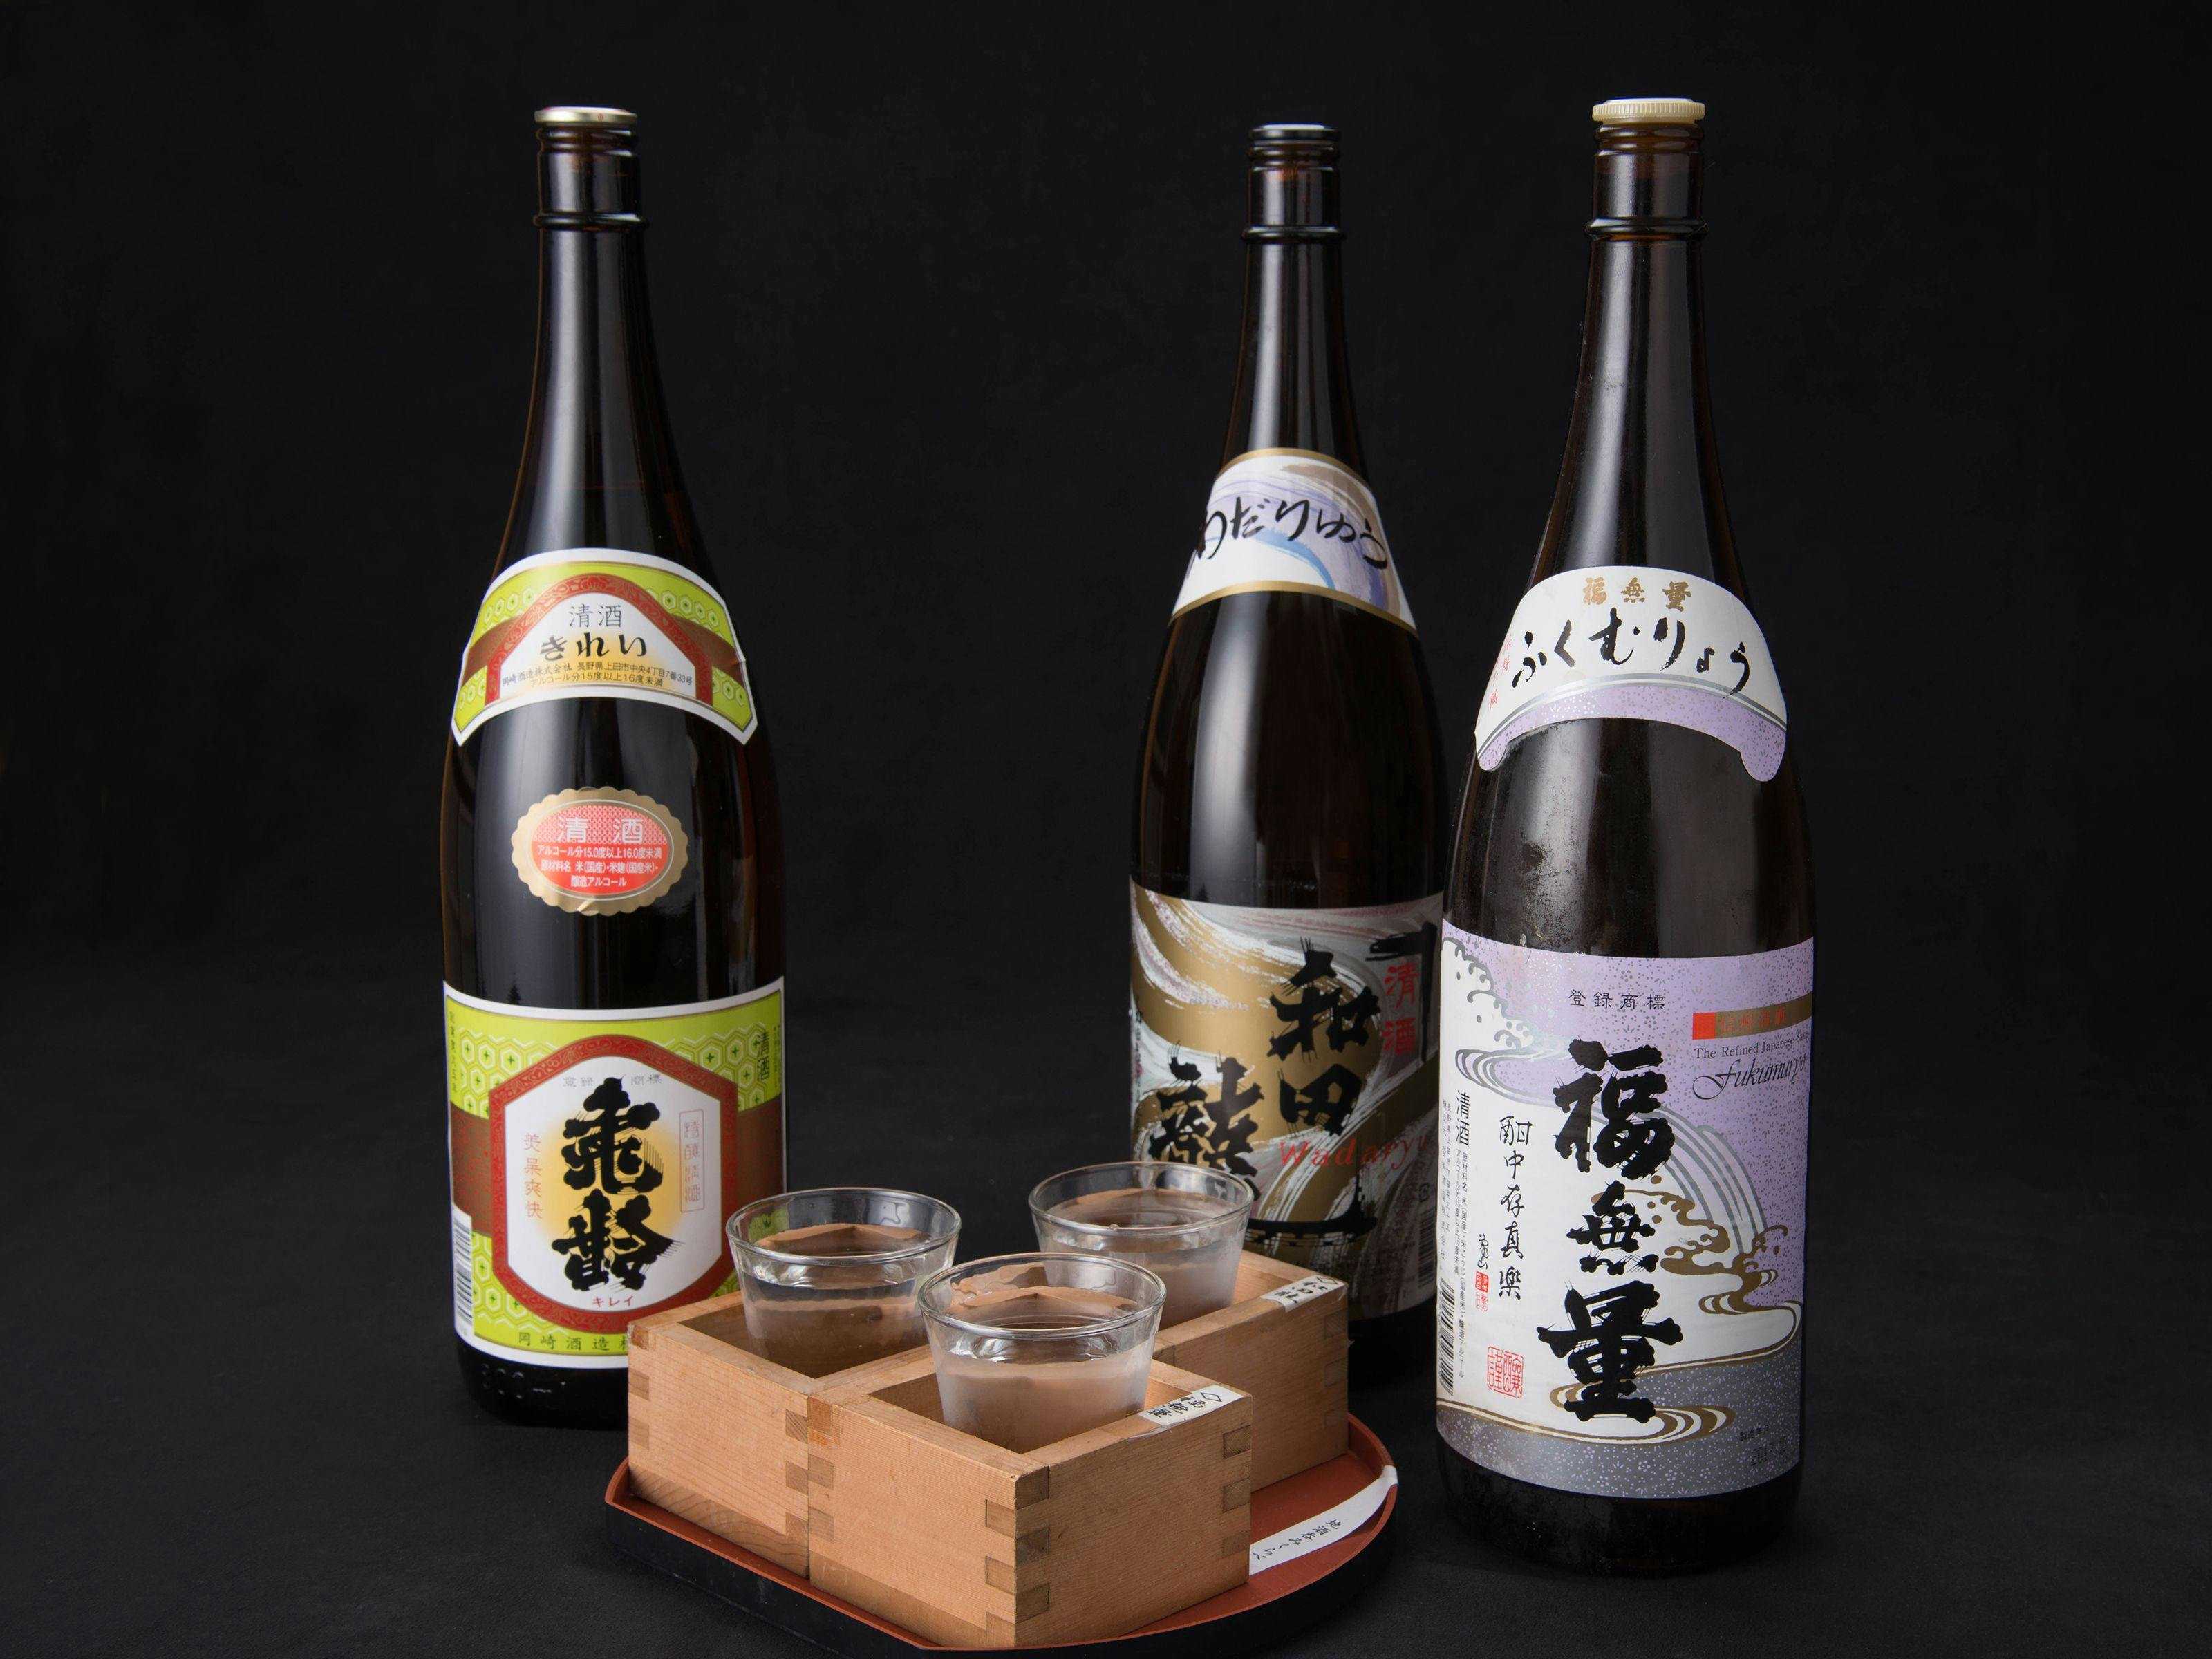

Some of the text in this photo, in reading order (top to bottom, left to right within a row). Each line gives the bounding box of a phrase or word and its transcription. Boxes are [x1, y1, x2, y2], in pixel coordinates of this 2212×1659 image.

[1582, 577, 1691, 612] 福無量
[570, 603, 622, 628] 清酒
[540, 632, 647, 662] きれい
[1511, 607, 1750, 699] ふくむりょう
[530, 671, 664, 688] アルコール分15度以上16度未満
[537, 845, 662, 859] アルコール分15.0度以上16.0度未満
[1382, 959, 1420, 1055] 清酒
[1568, 989, 1666, 1011] 登録商標
[1694, 1047, 1716, 1059] The
[1722, 1043, 1759, 1058] Refined
[1761, 1038, 1795, 1054] Japanese
[1456, 1090, 1470, 1147] 清酒
[1537, 1038, 1684, 1423] 福無量
[592, 1295, 634, 1308] キレイ
